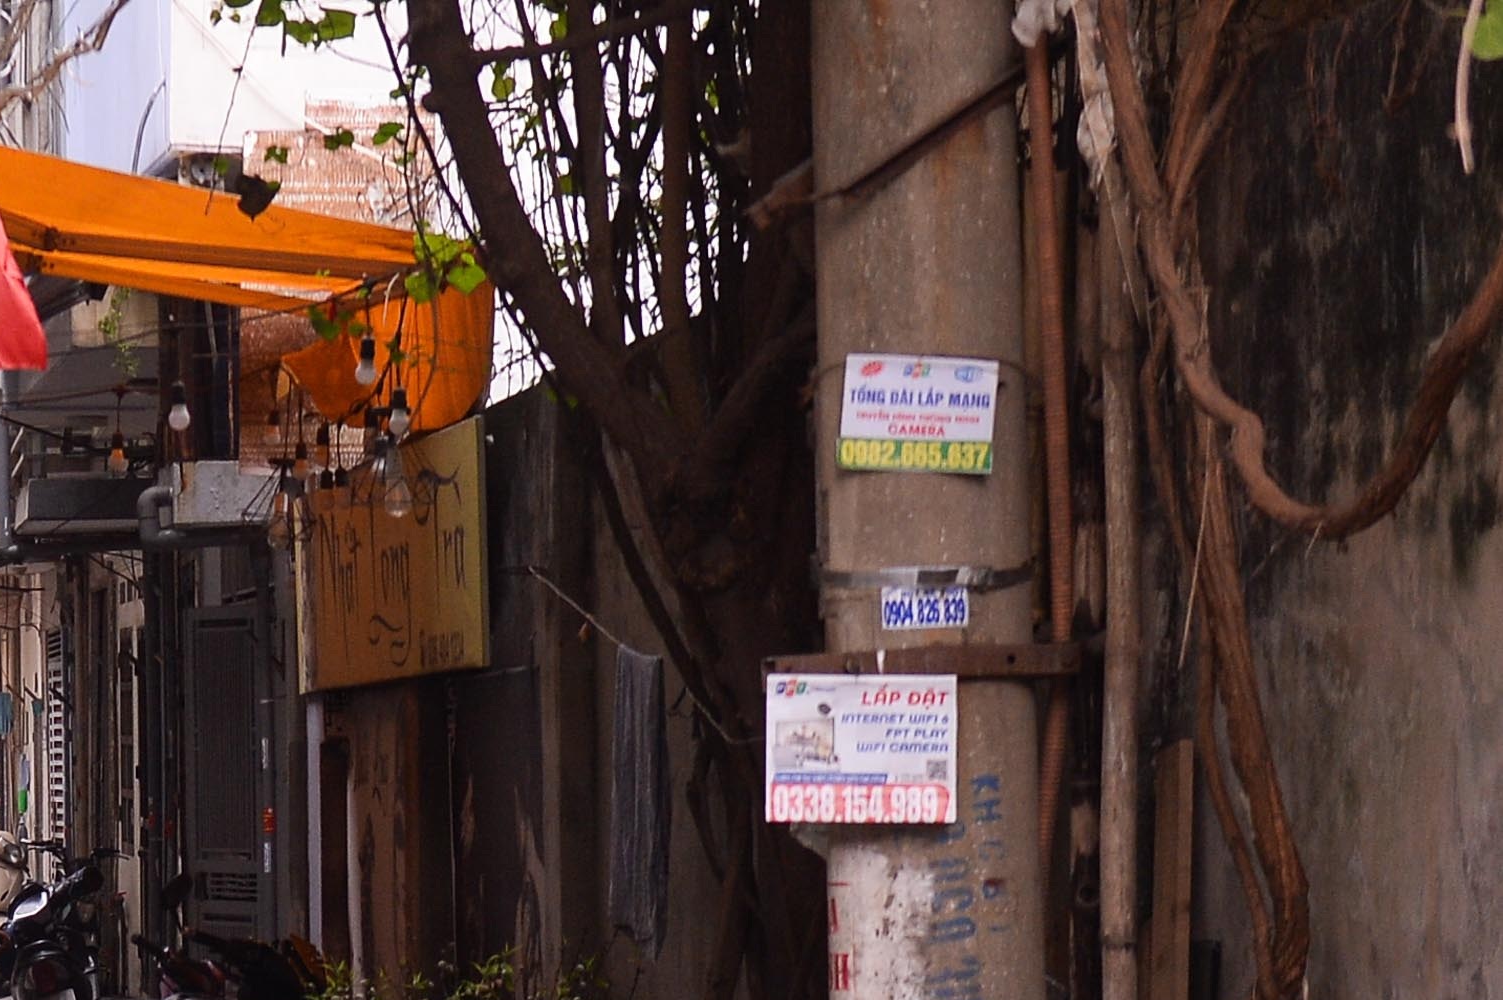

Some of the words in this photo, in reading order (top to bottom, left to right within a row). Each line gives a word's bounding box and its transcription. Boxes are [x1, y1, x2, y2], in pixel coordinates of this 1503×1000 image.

[888, 424, 946, 437] CAMERA
[861, 683, 901, 706] LẮP
[841, 713, 904, 724] INTERNET
[914, 729, 948, 738] PLAY
[889, 743, 949, 753] CAMERA
[773, 785, 938, 823] 0338.154.989
